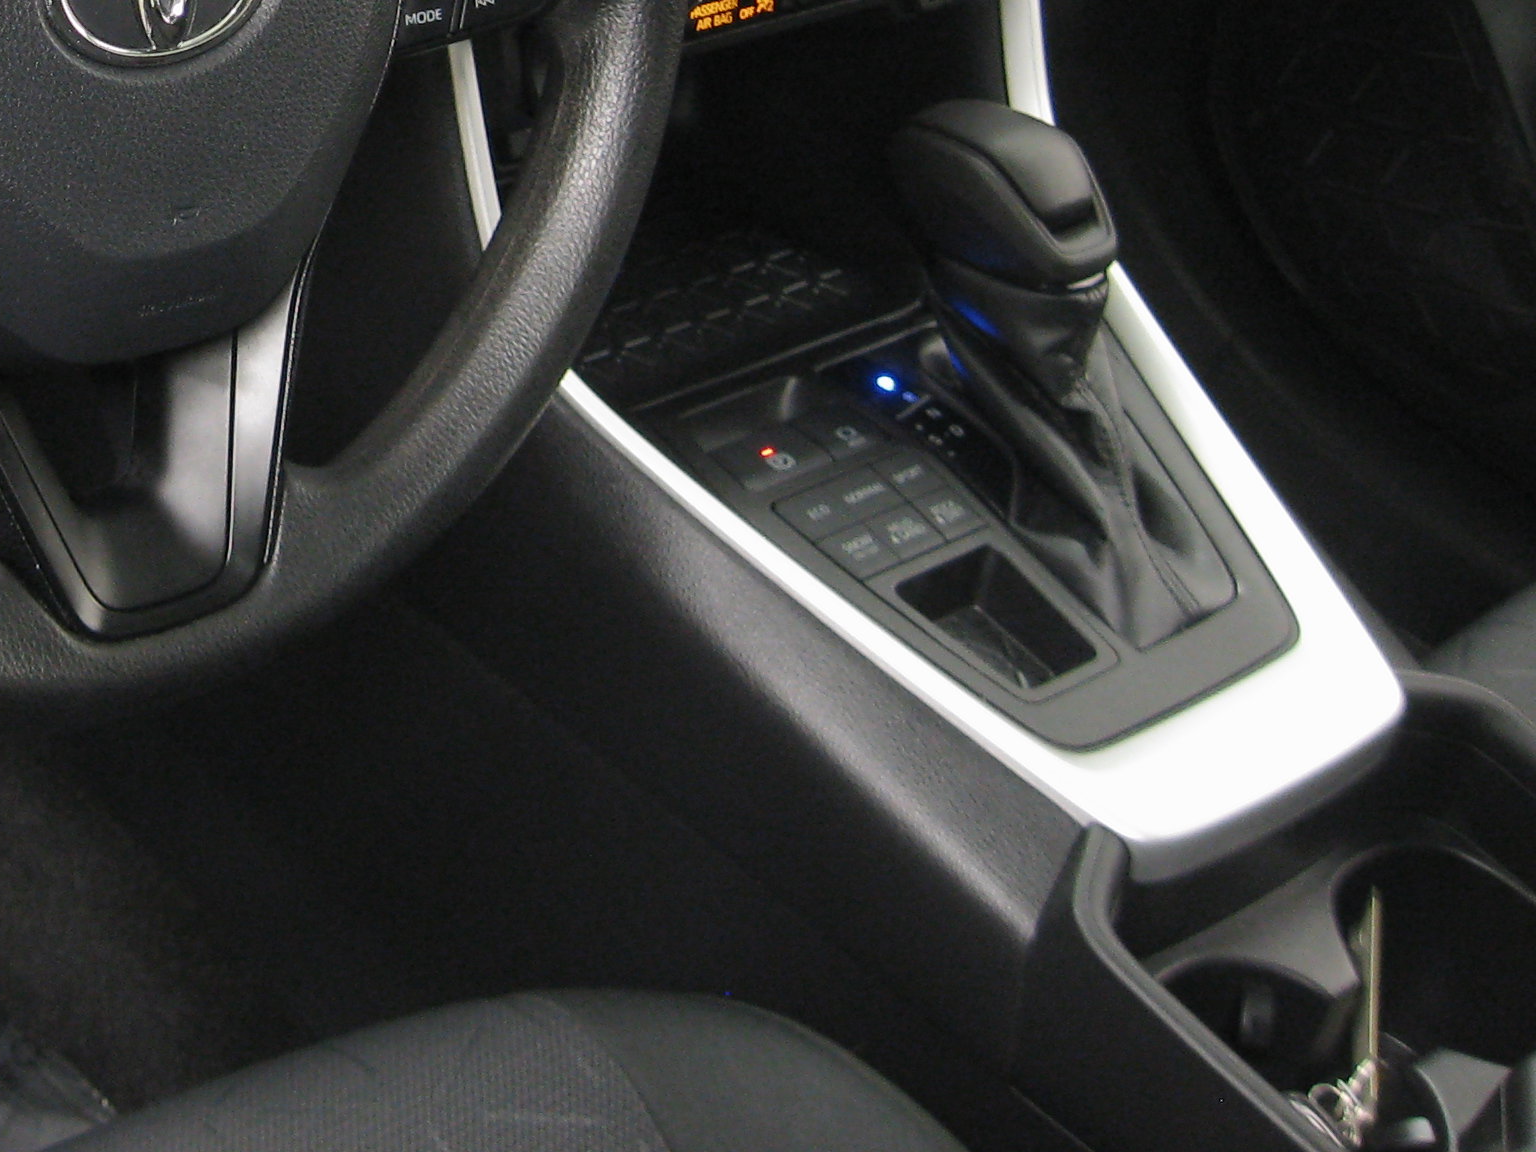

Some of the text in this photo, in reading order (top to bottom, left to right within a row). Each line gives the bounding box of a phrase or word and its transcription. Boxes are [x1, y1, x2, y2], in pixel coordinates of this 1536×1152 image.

[404, 8, 443, 26] MODE
[696, 6, 755, 31] AIR BAG OFF
